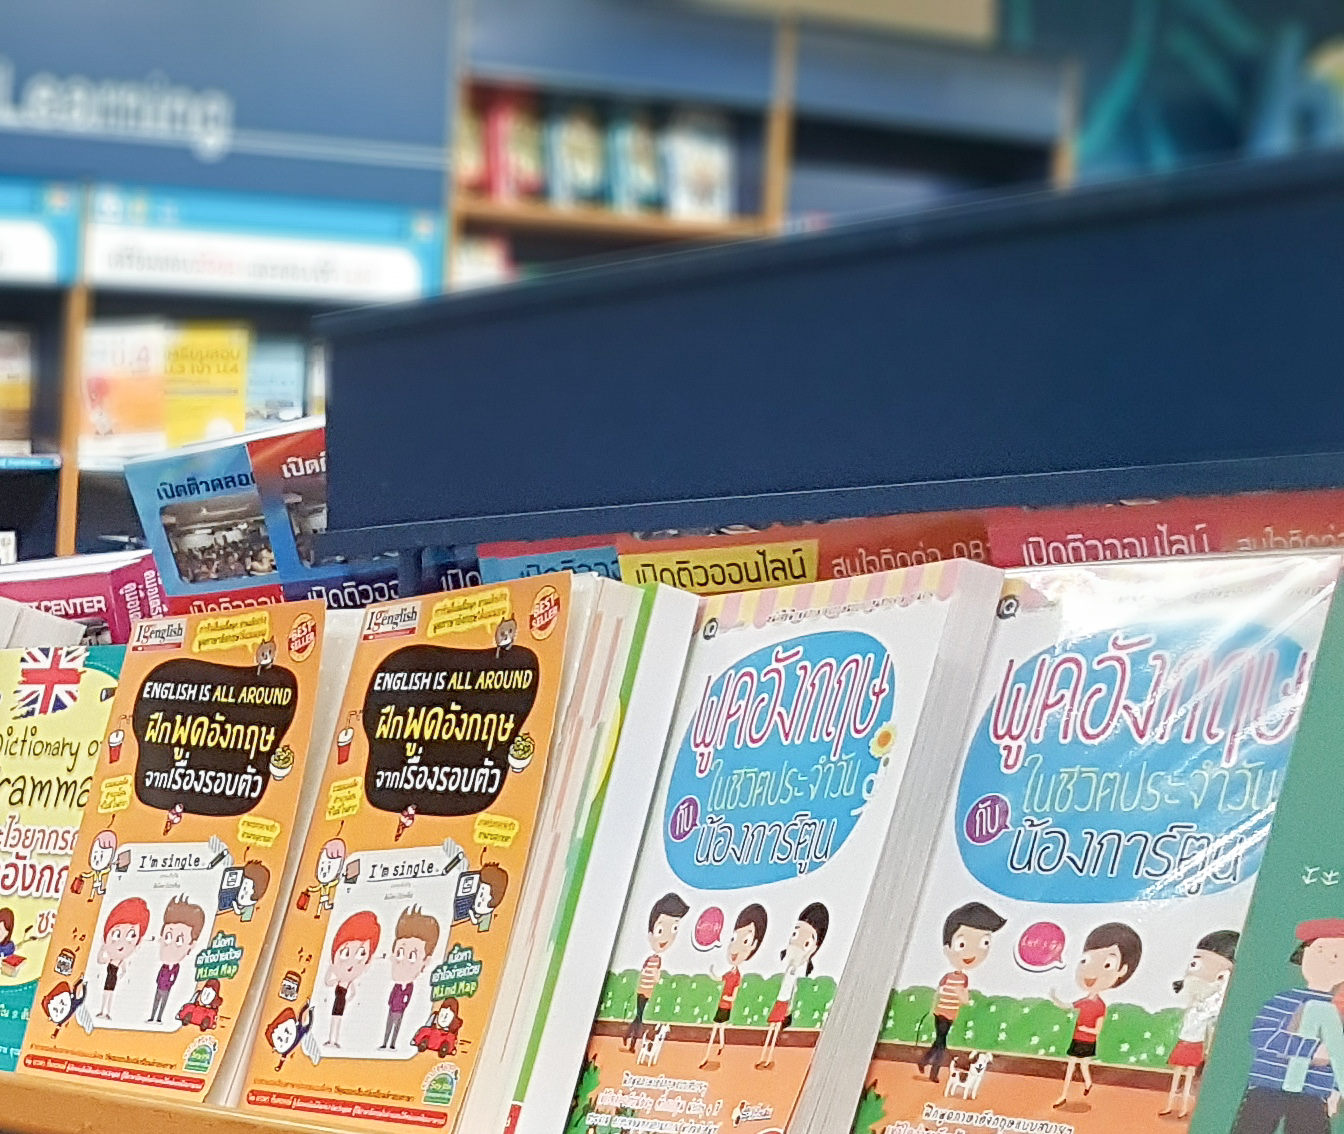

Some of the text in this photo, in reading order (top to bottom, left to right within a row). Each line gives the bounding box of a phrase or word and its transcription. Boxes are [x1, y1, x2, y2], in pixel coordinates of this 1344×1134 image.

[531, 606, 559, 629] SELLER
[533, 594, 556, 618] BEST
[289, 633, 316, 652] SELLER
[290, 621, 314, 640] BEST
[143, 681, 293, 706] ENGLISH IS ALL AROUND
[373, 669, 533, 691] ENGLISH IS ALL AROUND
[145, 710, 276, 760] ฝึกพูดอังกฤษ
[375, 702, 515, 757] ฝึกพูดอังกฤษ
[145, 751, 263, 799] จากเรื่องรอบตัว
[375, 746, 502, 795] จากเรื่องรอบตัว
[707, 753, 863, 812] ในชีวิตประจำวัน
[1021, 754, 1279, 814] ในชีวิตประจำวัน
[674, 802, 695, 837] กับ
[973, 801, 1002, 838] กับ
[694, 812, 837, 875] น้องการ์ตูน
[1008, 817, 1246, 896] น้องการ์ตูน
[139, 854, 159, 869] I'm
[369, 863, 389, 879] I'm
[432, 981, 477, 998] Mind Map
